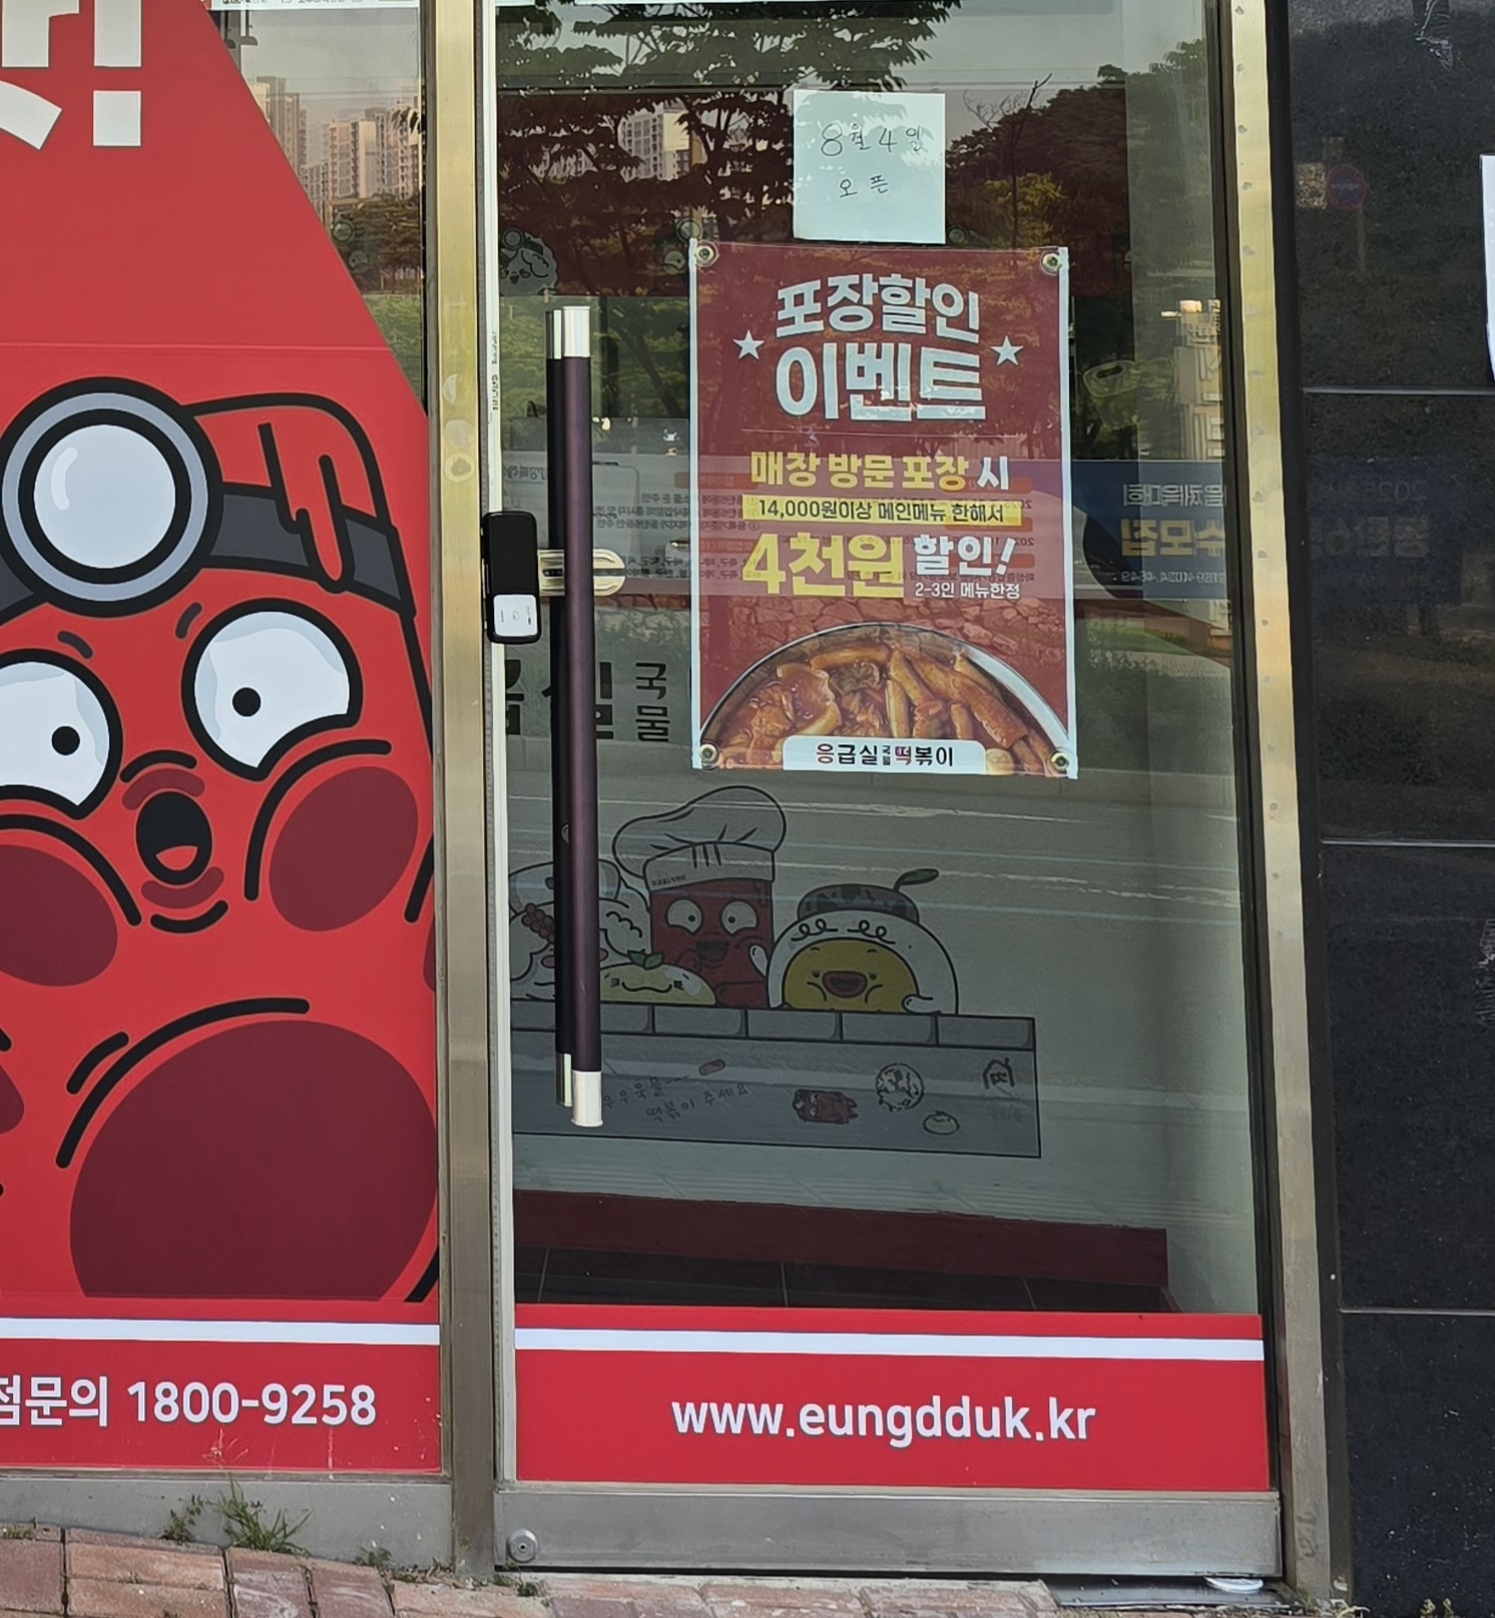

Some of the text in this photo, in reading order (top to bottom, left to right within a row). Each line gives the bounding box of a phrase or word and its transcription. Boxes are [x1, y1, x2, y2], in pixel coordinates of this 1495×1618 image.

[839, 174, 890, 198] 오픈
[775, 272, 980, 344] 포장할인
[775, 341, 987, 421] 이벤트
[750, 451, 1010, 492] 매장 방문 포장 시
[758, 499, 873, 520] 14,000원이상
[878, 502, 947, 523] 메인메뉴
[951, 502, 1004, 523] 한해서
[742, 531, 1016, 599] 4천원 할인!
[914, 582, 1021, 600] 2-3인 메뉴한정
[635, 661, 671, 743] 국물
[127, 1381, 377, 1426] 1800-9258
[671, 1395, 1097, 1449] www.eungdduk.kr
